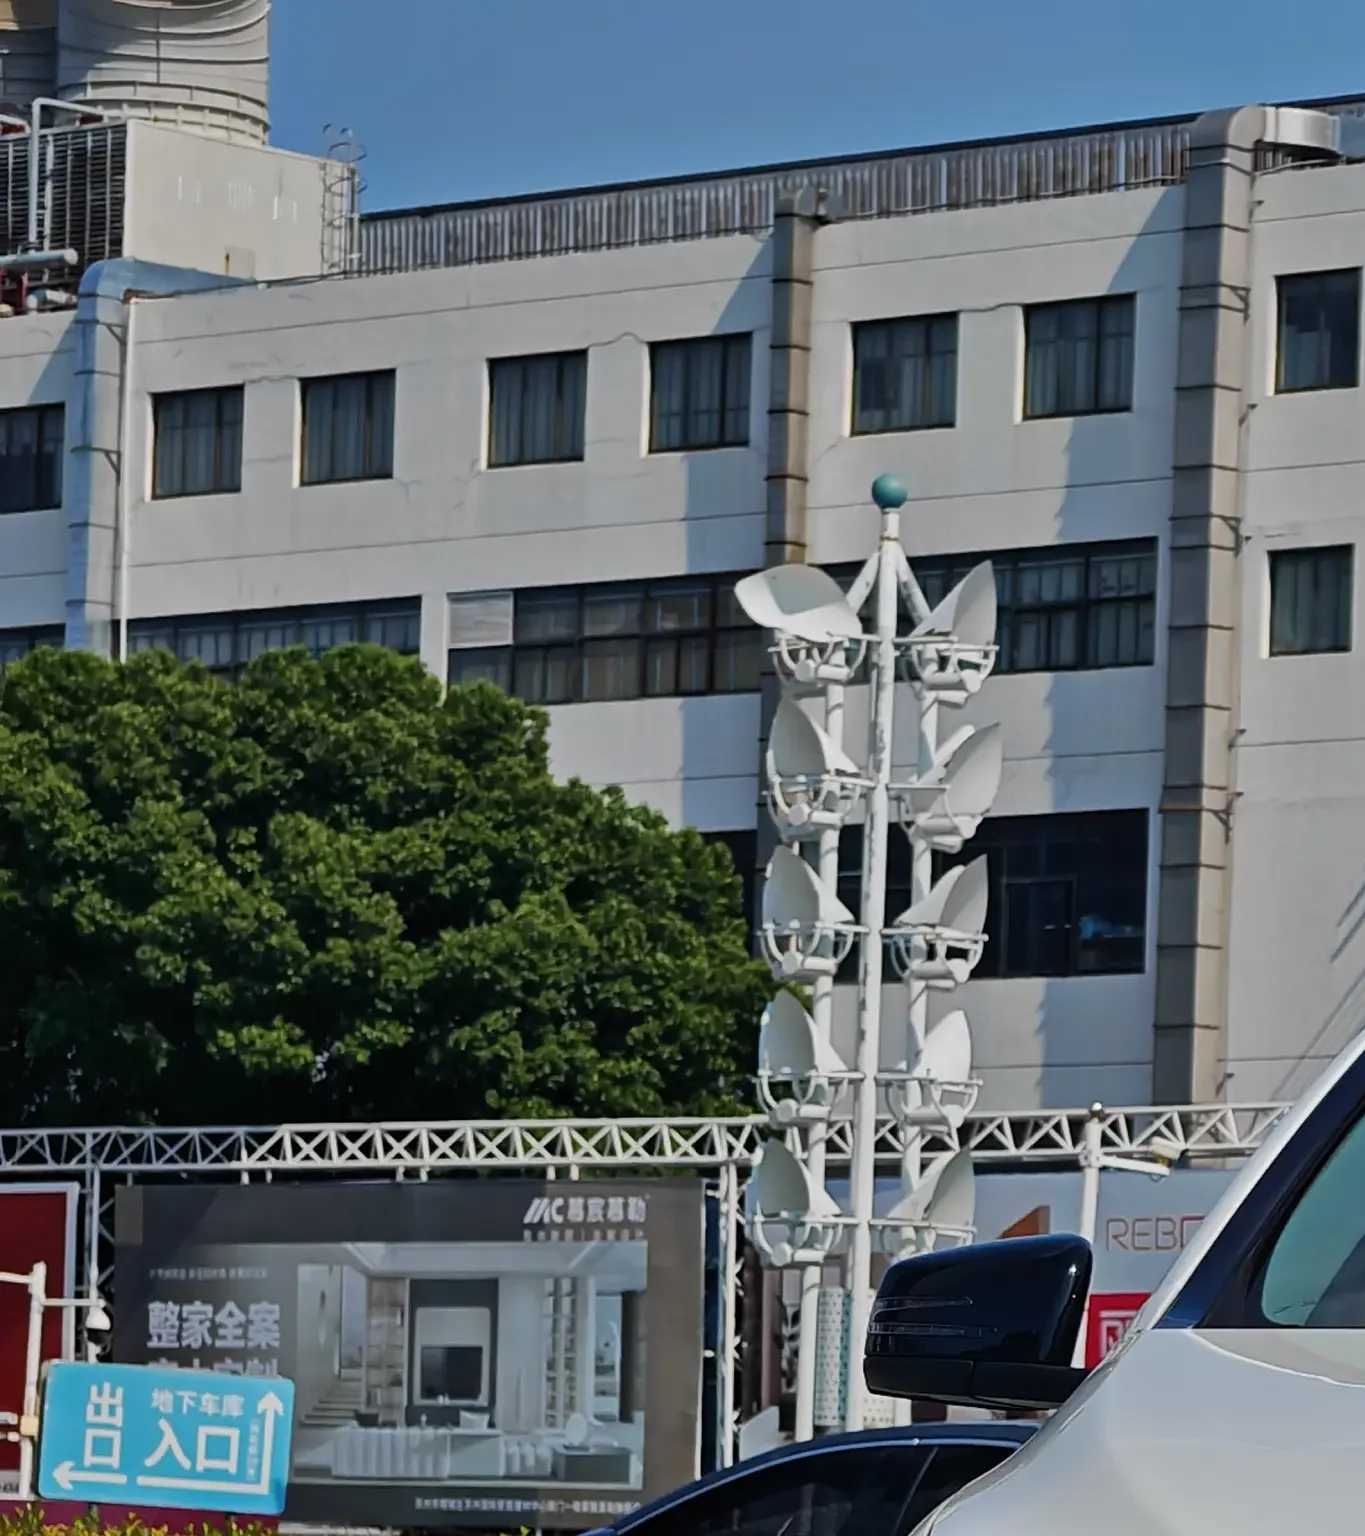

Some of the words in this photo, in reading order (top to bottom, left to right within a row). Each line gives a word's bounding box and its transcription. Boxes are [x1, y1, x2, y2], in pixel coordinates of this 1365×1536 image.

[147, 1300, 281, 1349] 整家全案
[84, 1382, 124, 1469] 出口
[151, 1388, 244, 1417] 地下车库
[144, 1418, 240, 1475] 入口
